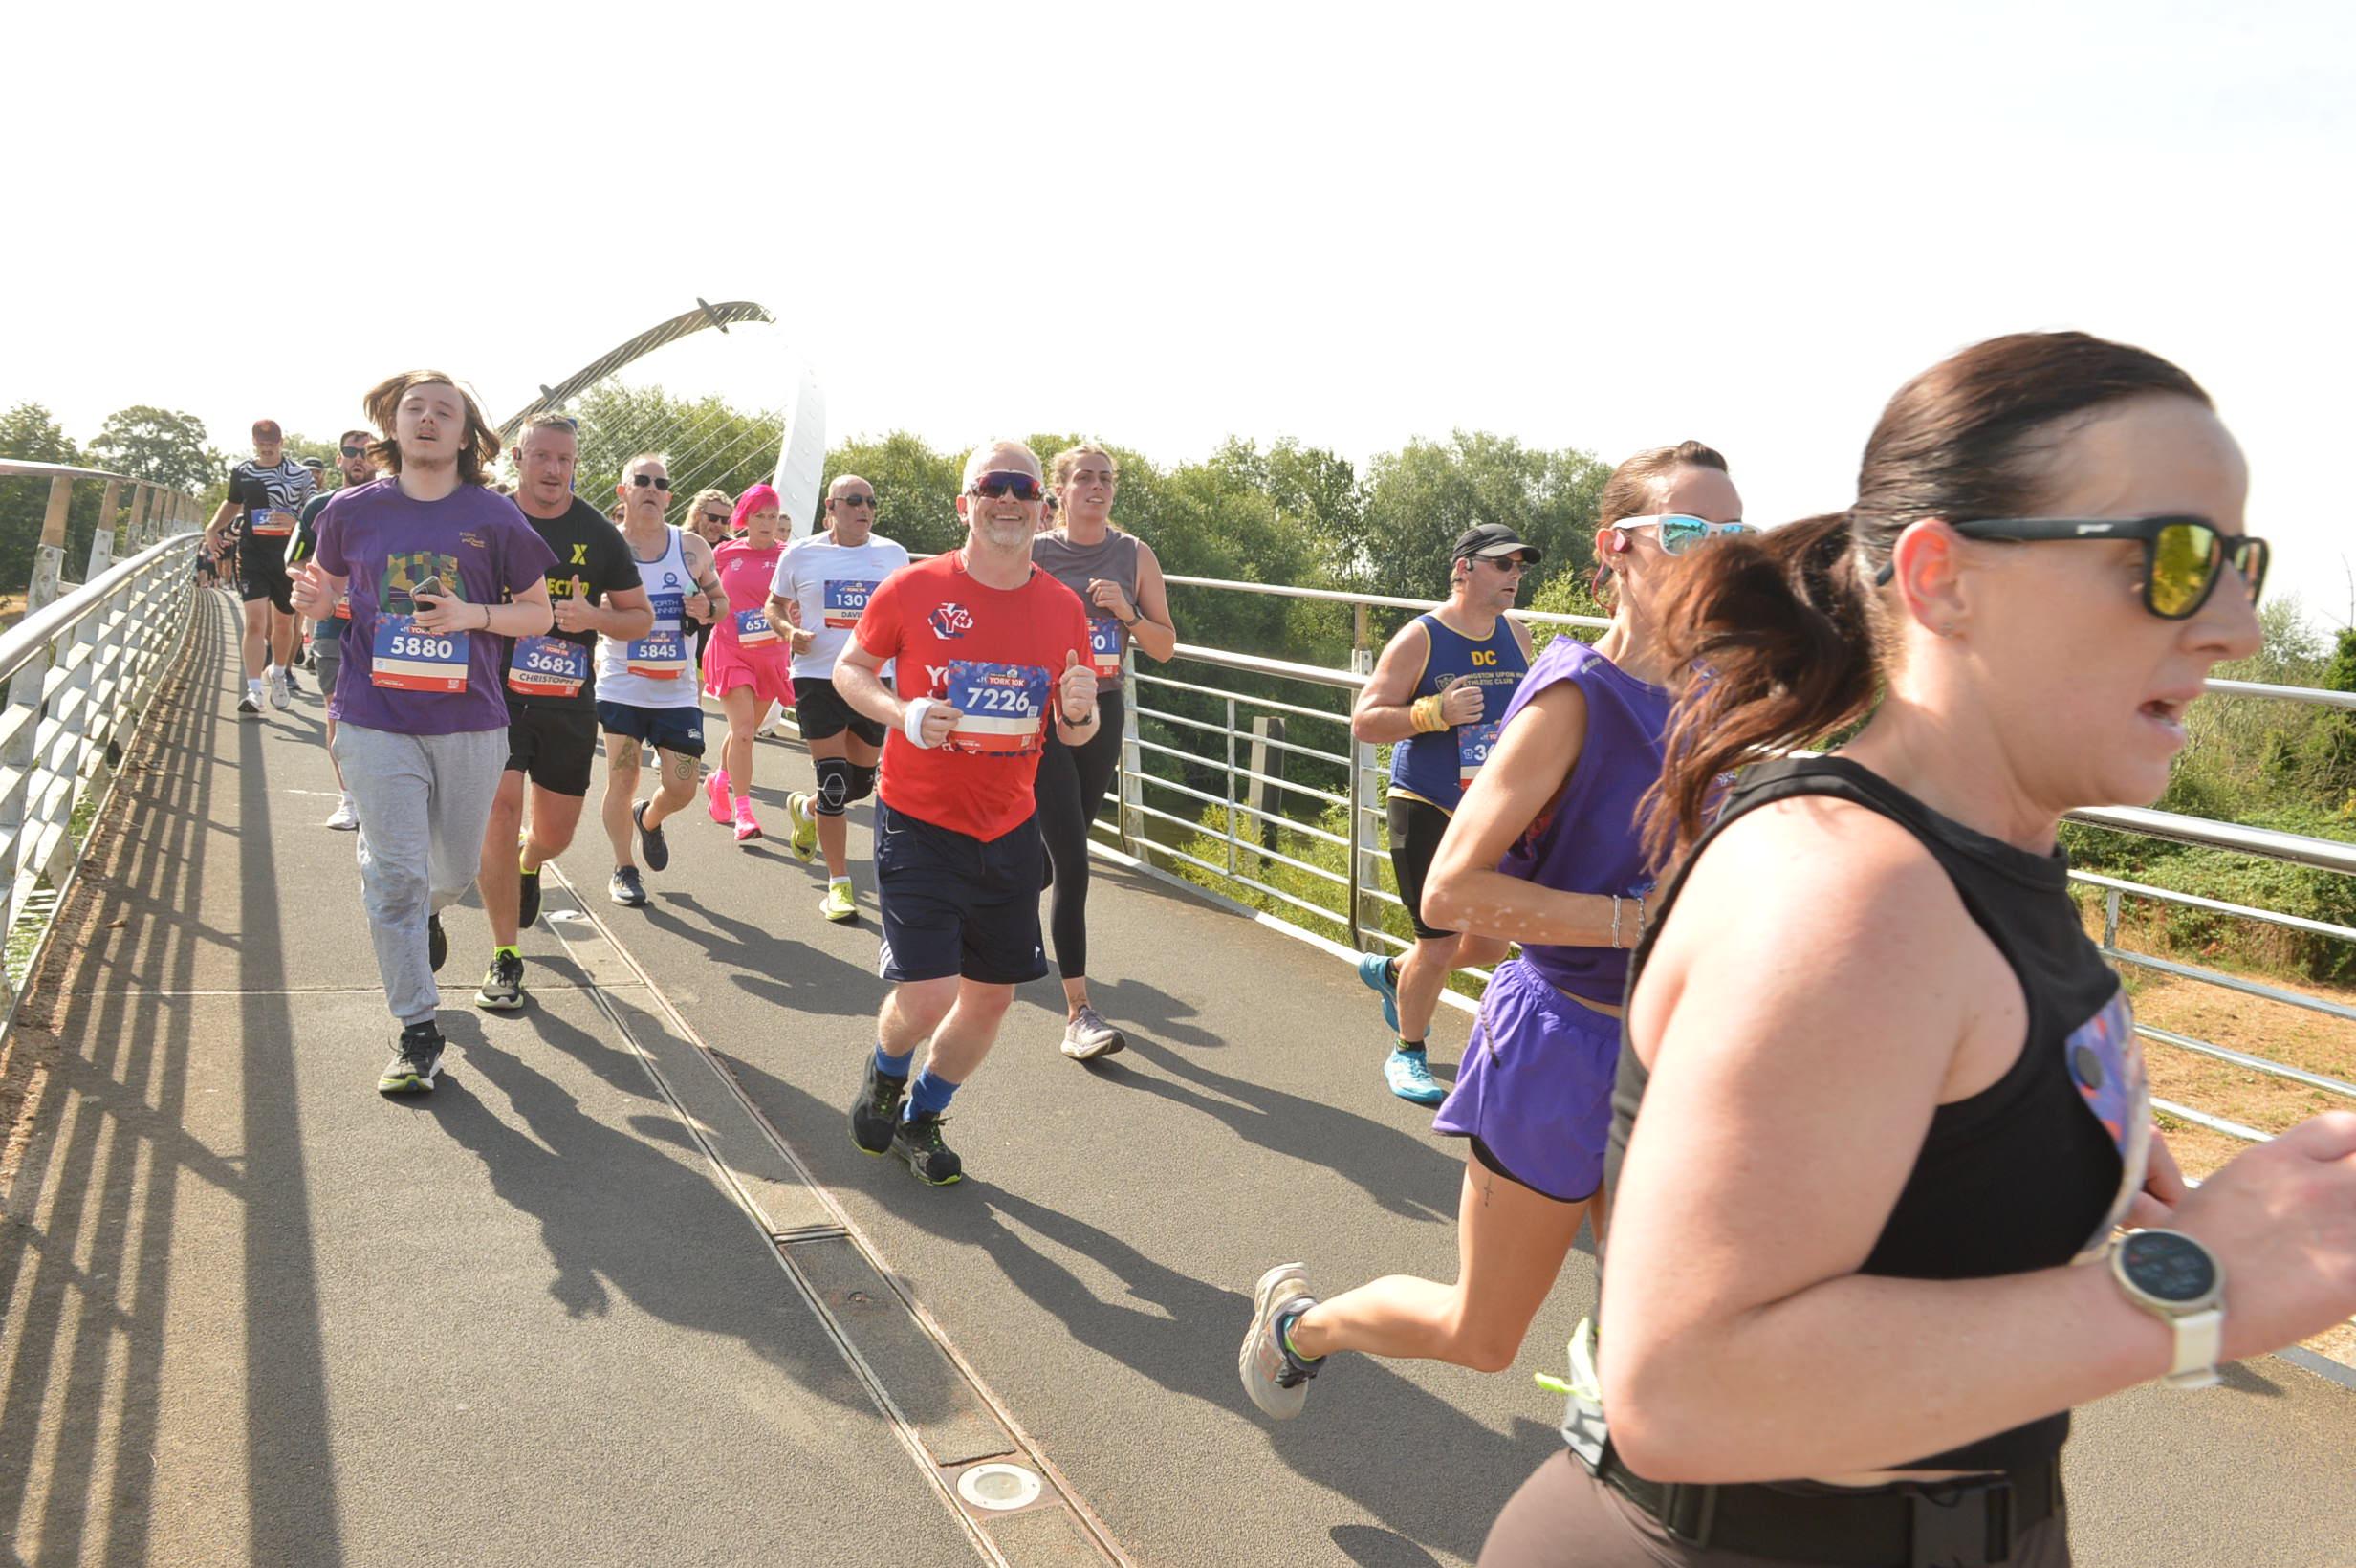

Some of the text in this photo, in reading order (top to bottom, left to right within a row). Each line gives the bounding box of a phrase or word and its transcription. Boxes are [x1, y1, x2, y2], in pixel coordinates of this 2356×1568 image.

[746, 618, 770, 631] 657
[390, 636, 453, 659] 5880
[639, 644, 677, 658] 5845
[527, 652, 576, 675] 3682
[1471, 650, 1498, 666] DC
[519, 673, 574, 685] CHRISTOPH
[989, 677, 1010, 686] YORK
[966, 687, 1030, 712] 7226
